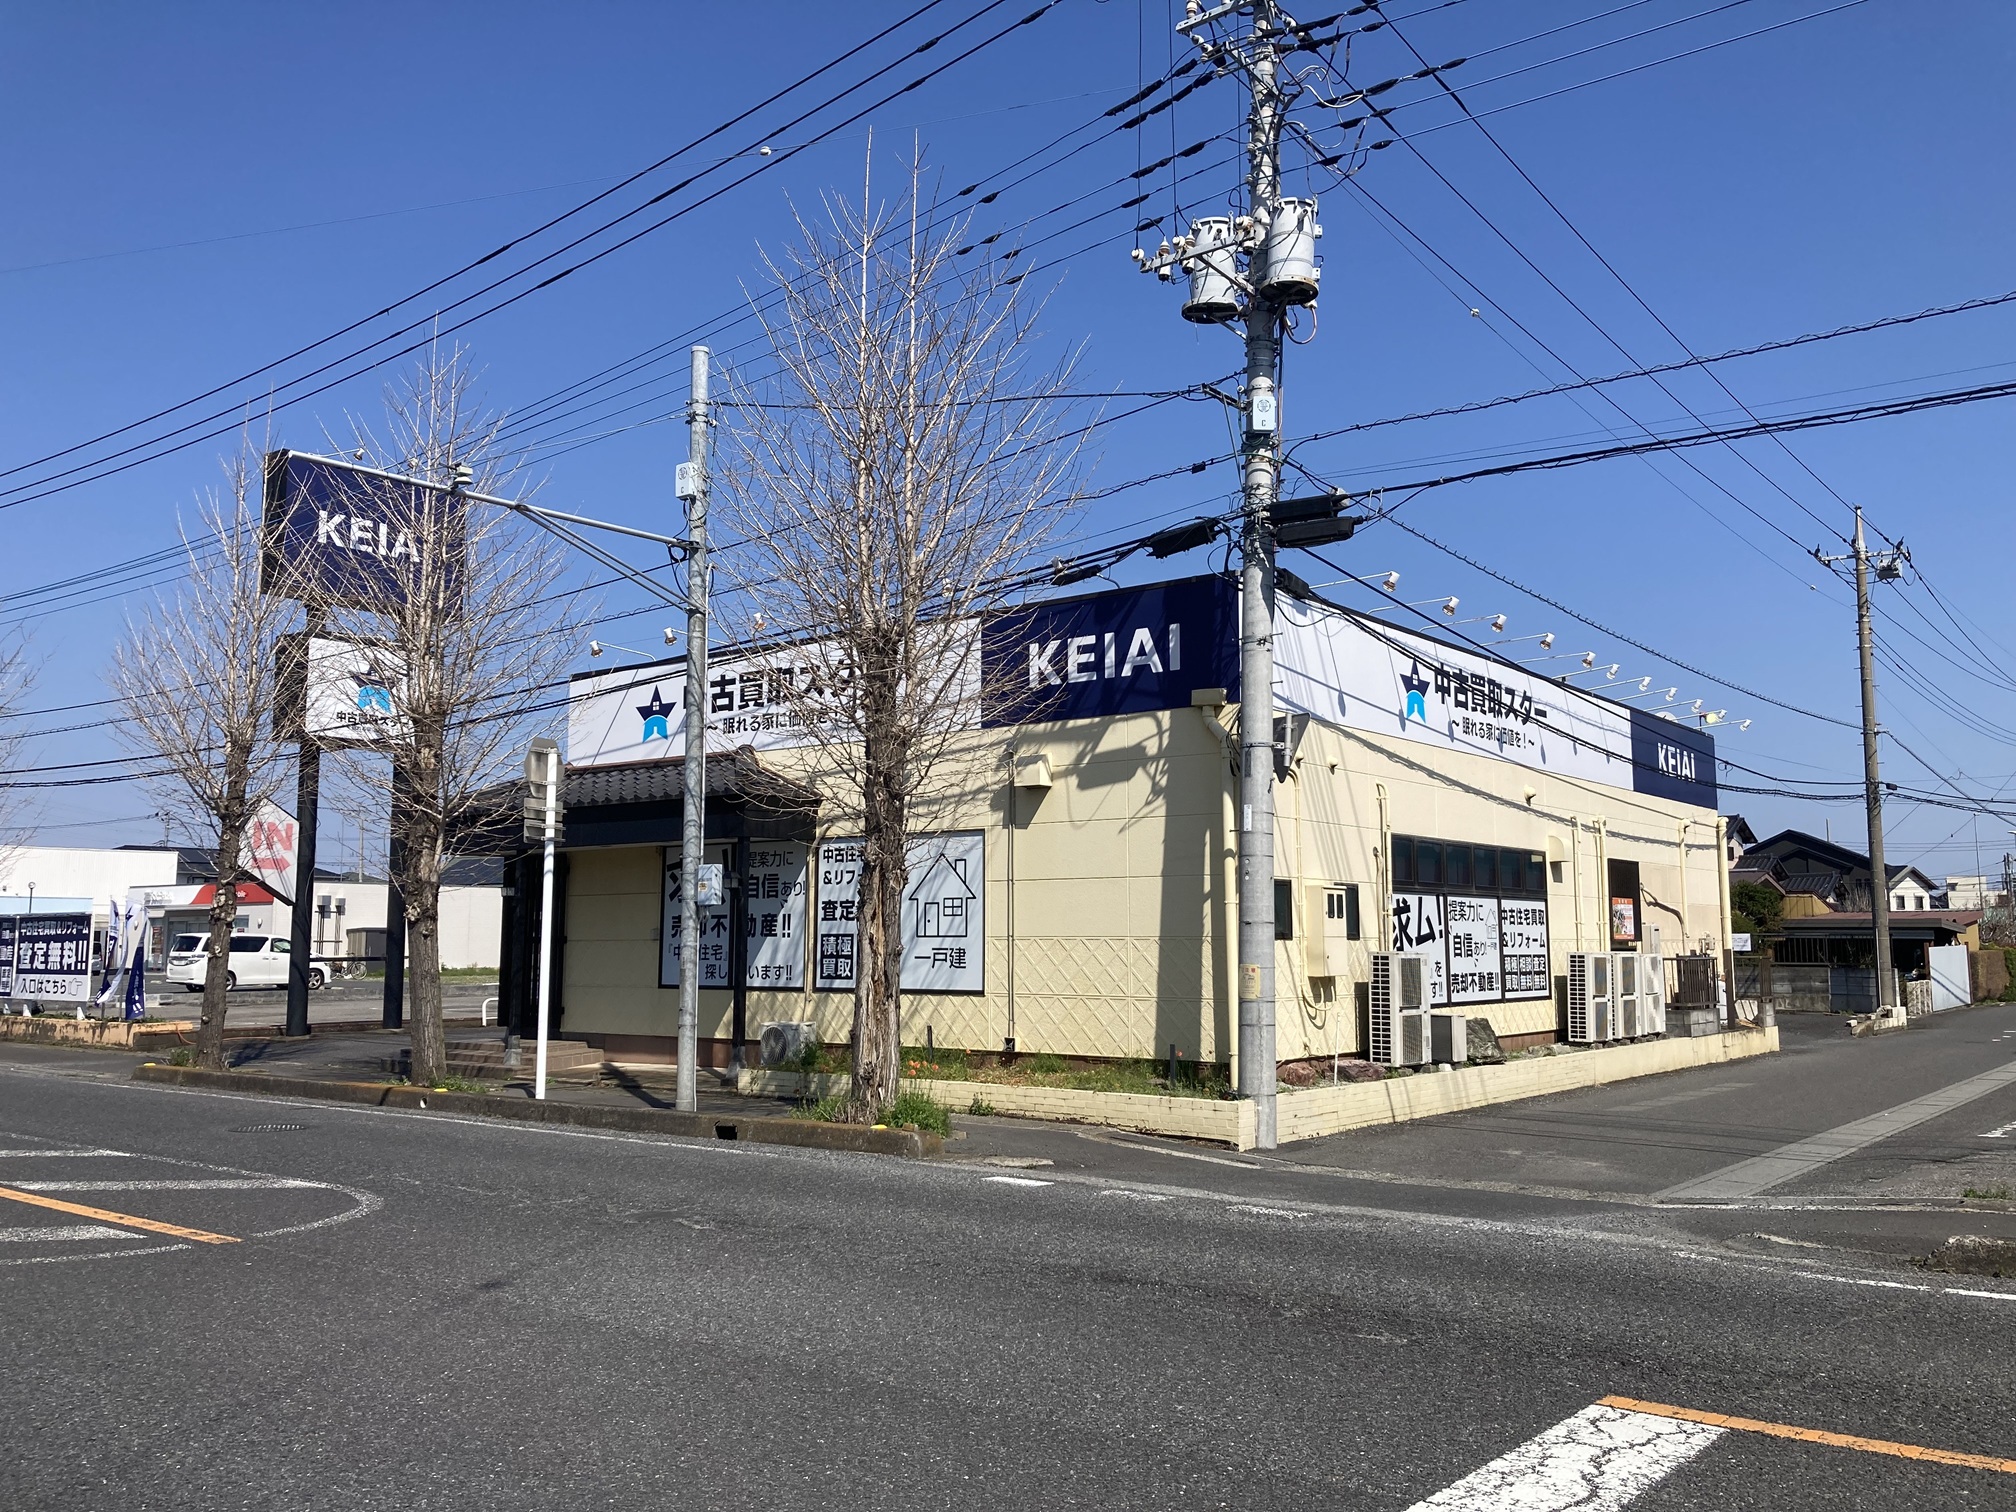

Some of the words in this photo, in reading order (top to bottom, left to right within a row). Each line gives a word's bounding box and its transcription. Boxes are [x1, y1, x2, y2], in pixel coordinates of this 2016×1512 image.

[317, 510, 420, 563] KEIA
[1029, 623, 1181, 688] KEIAI
[1434, 662, 1547, 726] 中古買取スター
[1657, 742, 1696, 783] KEIAI
[253, 820, 293, 851] IN
[1449, 900, 1484, 922] 提案力に
[1501, 907, 1545, 926] 中古住宅買取
[822, 937, 853, 956] 積極
[1502, 932, 1546, 949] &リフォーム
[18, 940, 87, 971] 査定無料!!
[914, 947, 967, 970] 一戸建
[822, 958, 852, 977] 買取
[21, 977, 67, 994] 入口はこちら
